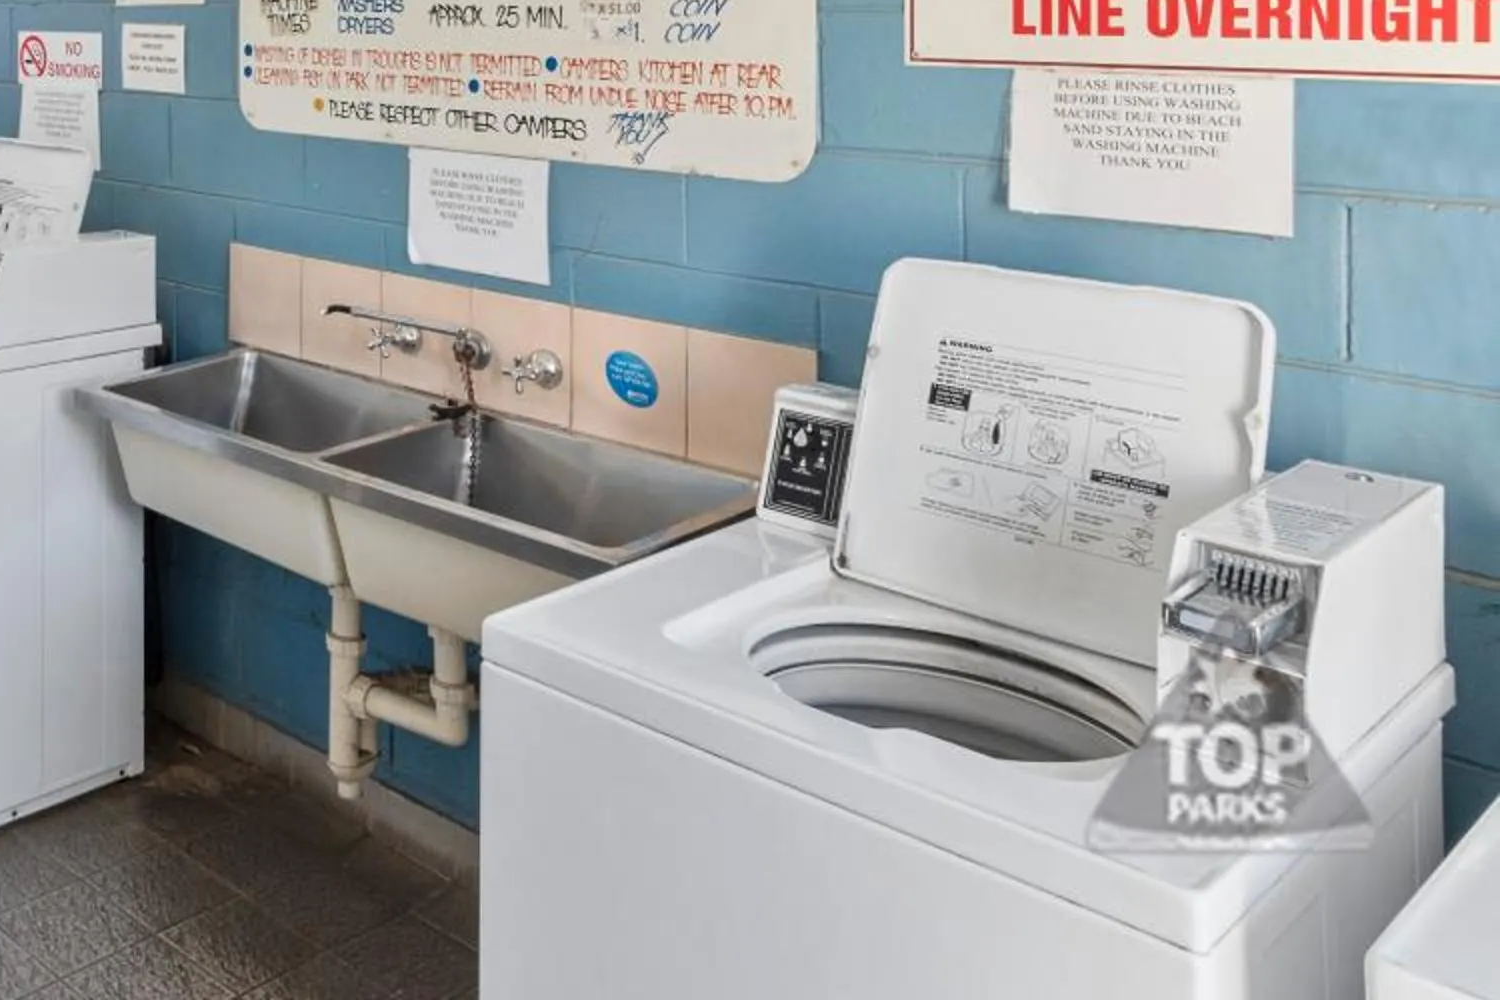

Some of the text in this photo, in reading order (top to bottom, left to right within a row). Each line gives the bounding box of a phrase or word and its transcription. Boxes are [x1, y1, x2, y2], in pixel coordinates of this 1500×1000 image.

[495, 3, 521, 28] 25
[526, 4, 567, 30] MIN.
[267, 12, 312, 36] TIMES
[337, 16, 395, 35] DRYERS
[664, 21, 721, 43] COIN
[65, 41, 83, 57] NO
[47, 62, 101, 79] SMOKING
[470, 53, 542, 77] PERMITTED
[560, 57, 629, 82] CAMPERS
[639, 58, 703, 85] KITCHEN
[710, 62, 731, 88] AT
[737, 62, 782, 89] REAR
[1057, 77, 1236, 96] PLEASE RINSE CLOTHES
[483, 79, 537, 101] REFRAIN
[544, 82, 583, 106] FROM
[645, 89, 689, 114] NOISE
[693, 91, 739, 116] AFTER
[1053, 92, 1242, 111] BEFORE USING WASHING
[329, 99, 376, 122] PLEASE
[379, 102, 441, 127] RESPECT
[445, 108, 500, 133] OTHER
[503, 113, 588, 141] CAMPERS
[1053, 107, 1242, 128] MACHINE DUE TO BEACH
[1063, 122, 1230, 142] SAND STAYING IN THE
[1072, 138, 1220, 158] WASHING MACHINE
[1100, 155, 1191, 171] THANK YOU
[949, 339, 993, 353] WARNING
